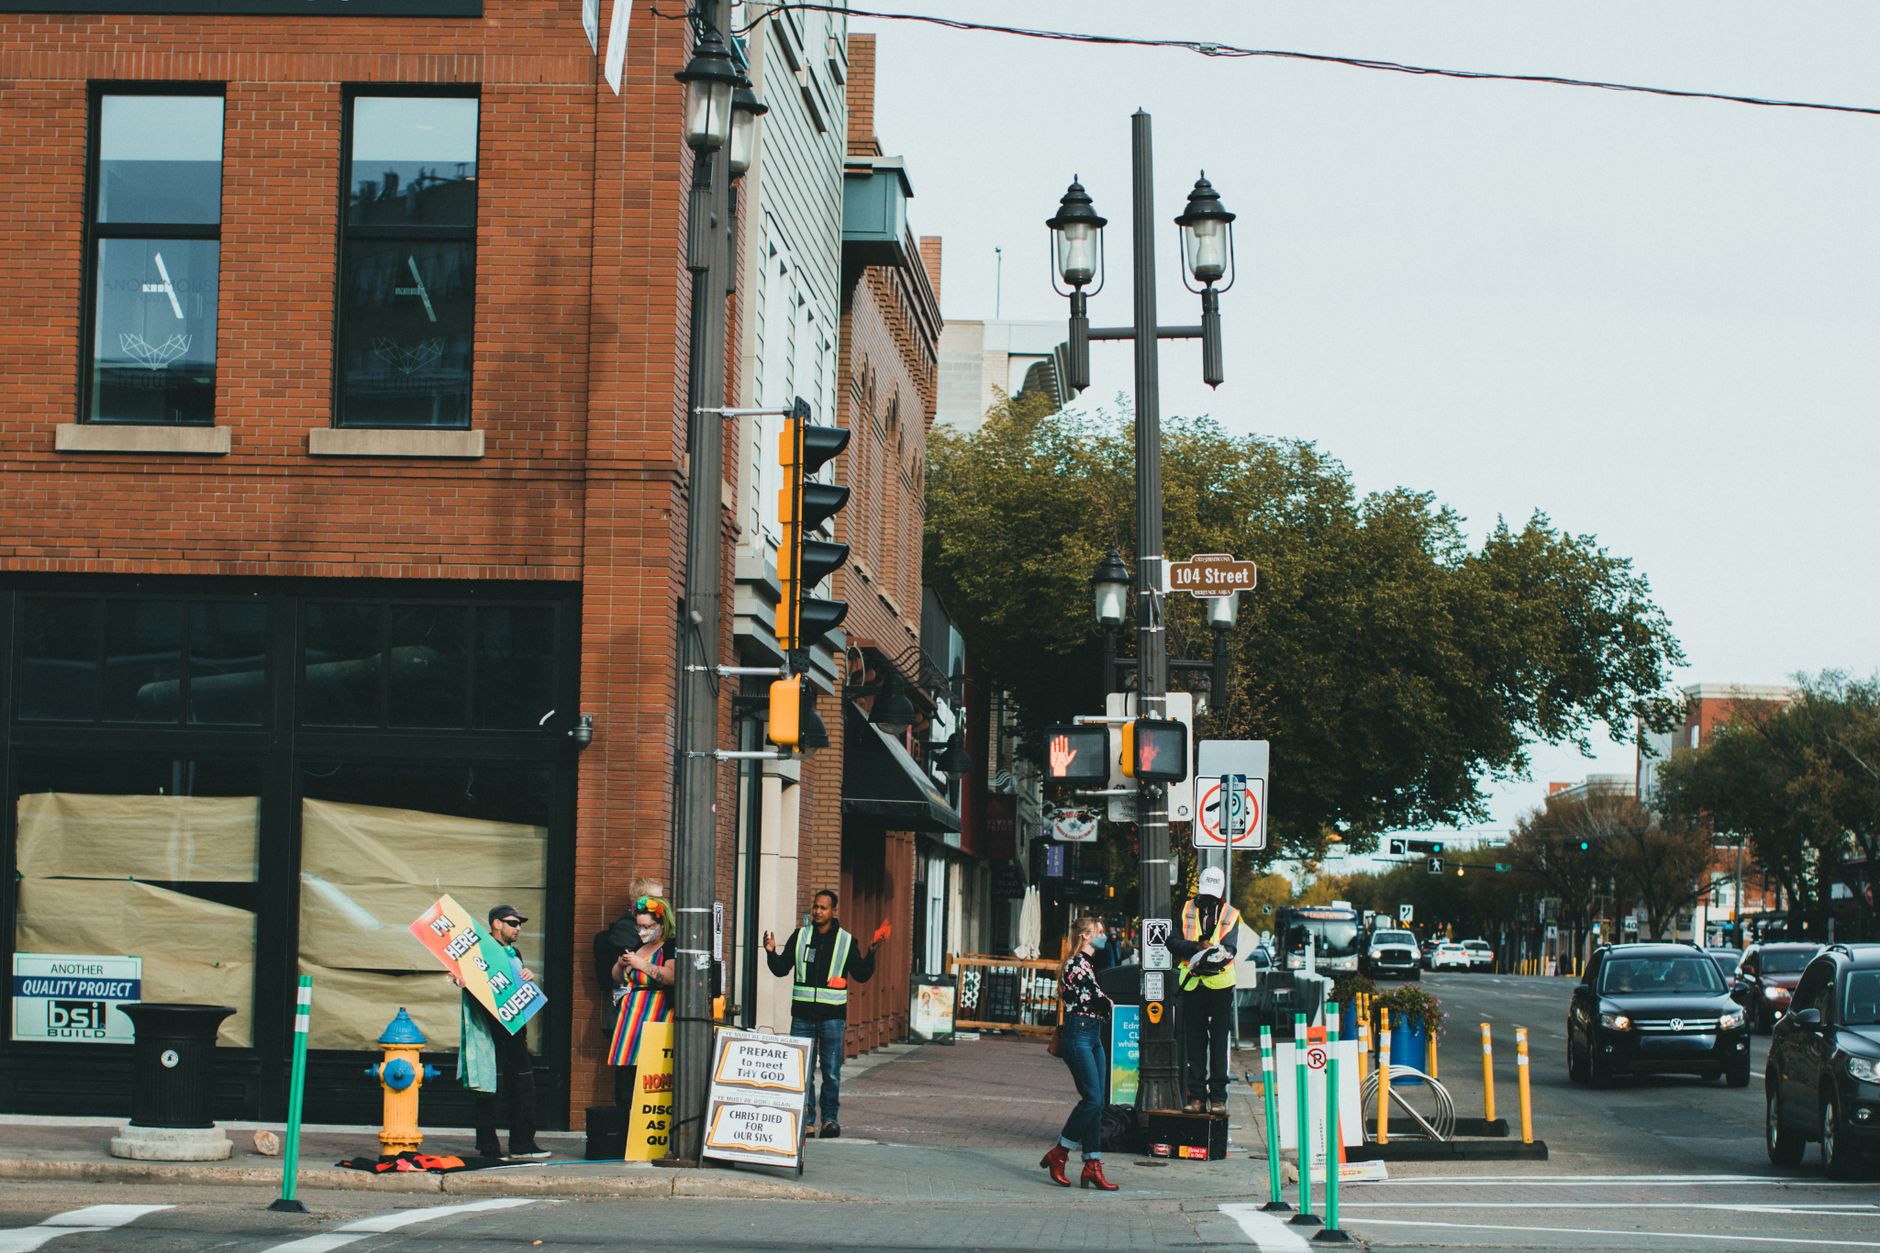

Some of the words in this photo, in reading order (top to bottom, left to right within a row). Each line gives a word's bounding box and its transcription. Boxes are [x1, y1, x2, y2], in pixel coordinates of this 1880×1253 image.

[1176, 568, 1200, 584] 104
[1205, 567, 1249, 584] Street
[444, 928, 481, 961] HERE
[50, 964, 104, 975] ANOTHER
[473, 956, 489, 972] &
[22, 980, 76, 996] QUALITY
[78, 981, 132, 997] PROJECT
[498, 983, 540, 1022] QUEER
[49, 1000, 99, 1028] bsi
[48, 1029, 106, 1038] BUILD
[740, 1046, 788, 1060] PREPARE
[742, 1058, 752, 1066] to
[756, 1062, 783, 1070] meet
[738, 1068, 757, 1078] THY
[760, 1071, 785, 1081] GOD
[730, 1110, 759, 1121] CHRIST
[761, 1113, 782, 1124] DIED
[646, 1120, 666, 1130] AS
[745, 1122, 763, 1131] FOR
[734, 1131, 752, 1140] OUR
[754, 1133, 773, 1142] SINS
